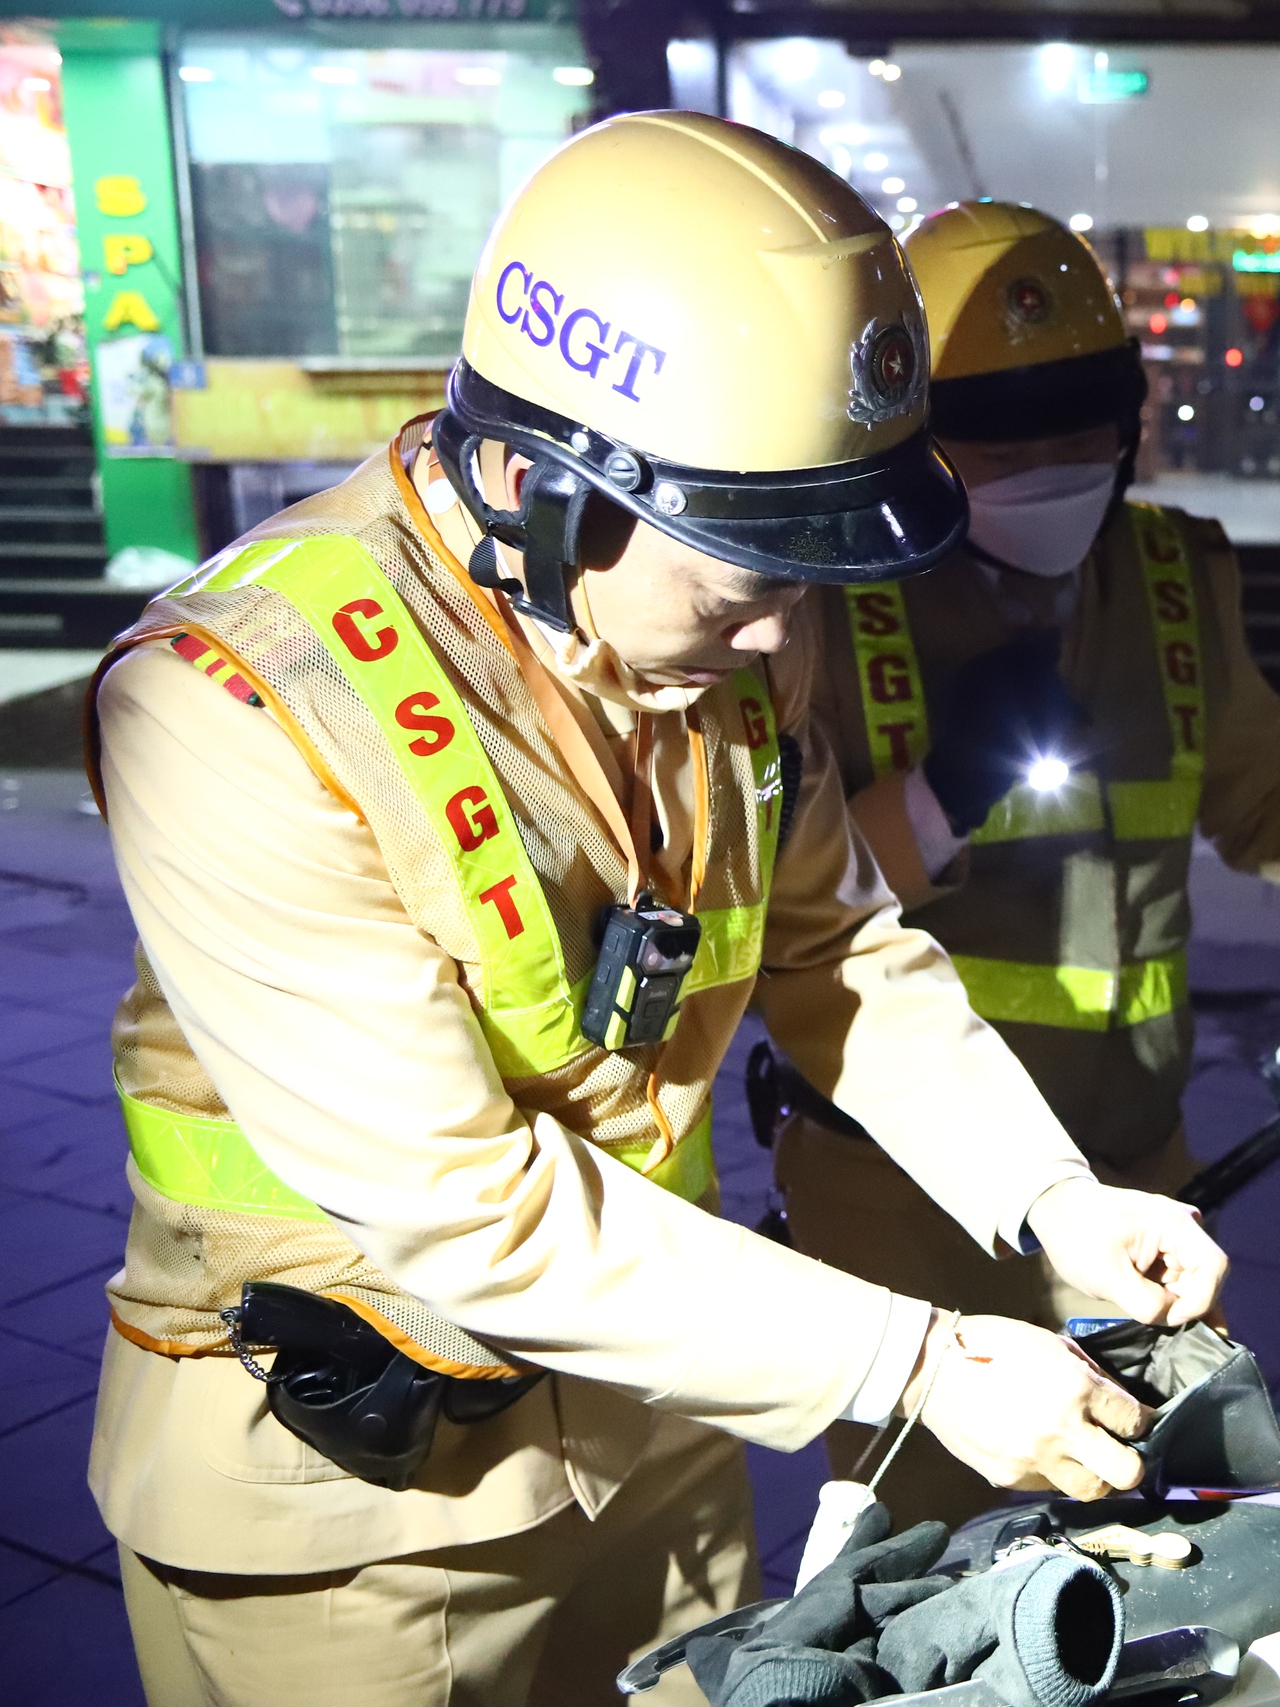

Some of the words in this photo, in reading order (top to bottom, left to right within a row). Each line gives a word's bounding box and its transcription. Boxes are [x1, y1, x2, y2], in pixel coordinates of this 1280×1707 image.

[94, 175, 160, 332] SPA
[496, 261, 667, 403] CSGT
[856, 592, 916, 773] SGT
[1143, 518, 1200, 751] CSGT
[332, 598, 525, 940] CSGT
